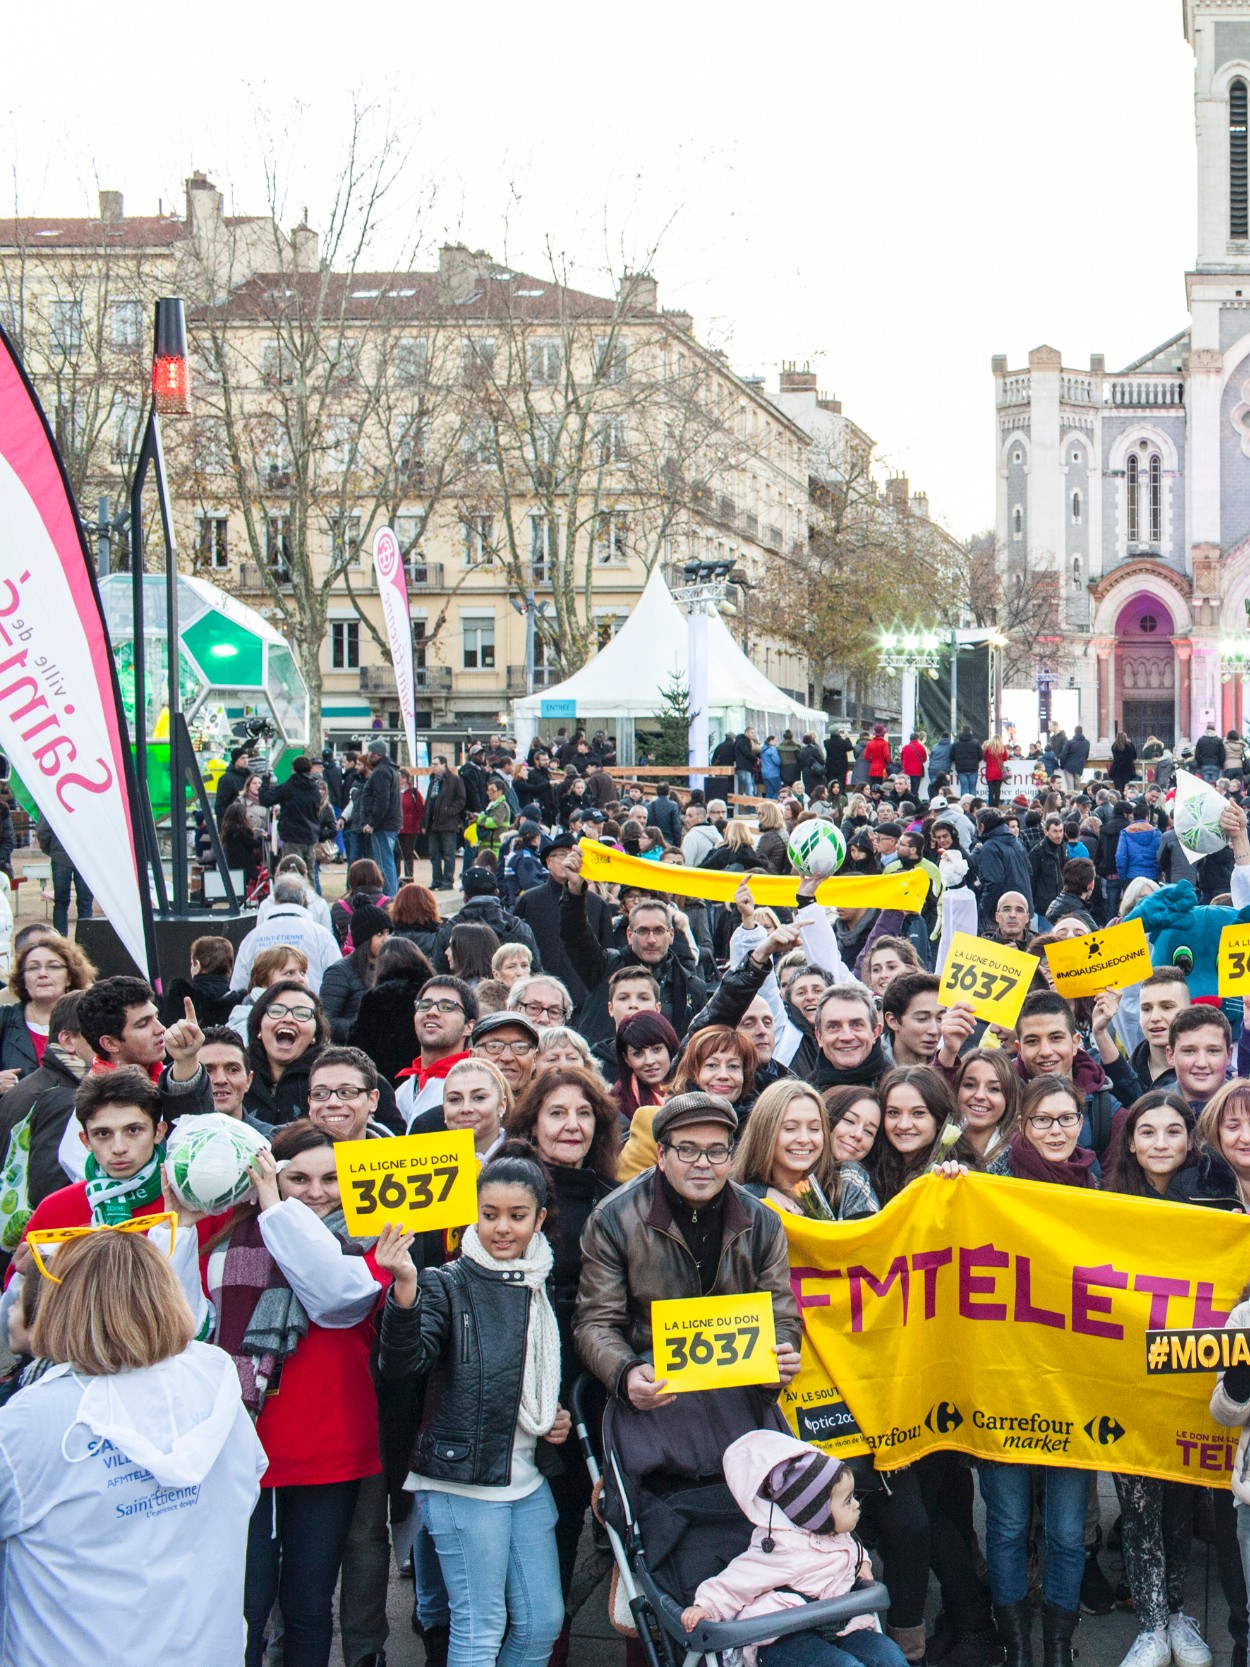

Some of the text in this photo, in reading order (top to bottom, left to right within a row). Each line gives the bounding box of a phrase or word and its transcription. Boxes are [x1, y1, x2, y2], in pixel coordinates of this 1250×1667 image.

[965, 953, 988, 965] LIGNE
[989, 961, 1001, 969] DU
[1002, 965, 1022, 977] DON
[1056, 948, 1145, 979] #MOIAUSSIJEDONNE
[945, 962, 1018, 1001] 3637
[350, 1153, 458, 1173] LA LIGNE DU DON
[351, 1166, 459, 1215] 3637
[664, 1314, 759, 1331] LA LIGNE DU DON
[665, 1326, 760, 1372] 3637
[801, 1391, 814, 1402] LE
[816, 1386, 840, 1400] SOUT
[972, 1410, 1074, 1435] Carrefour
[1002, 1434, 1072, 1452] market
[1176, 1430, 1239, 1445] LE DON EN LIG
[103, 1454, 132, 1469] VILL
[116, 1498, 153, 1518] Saint
